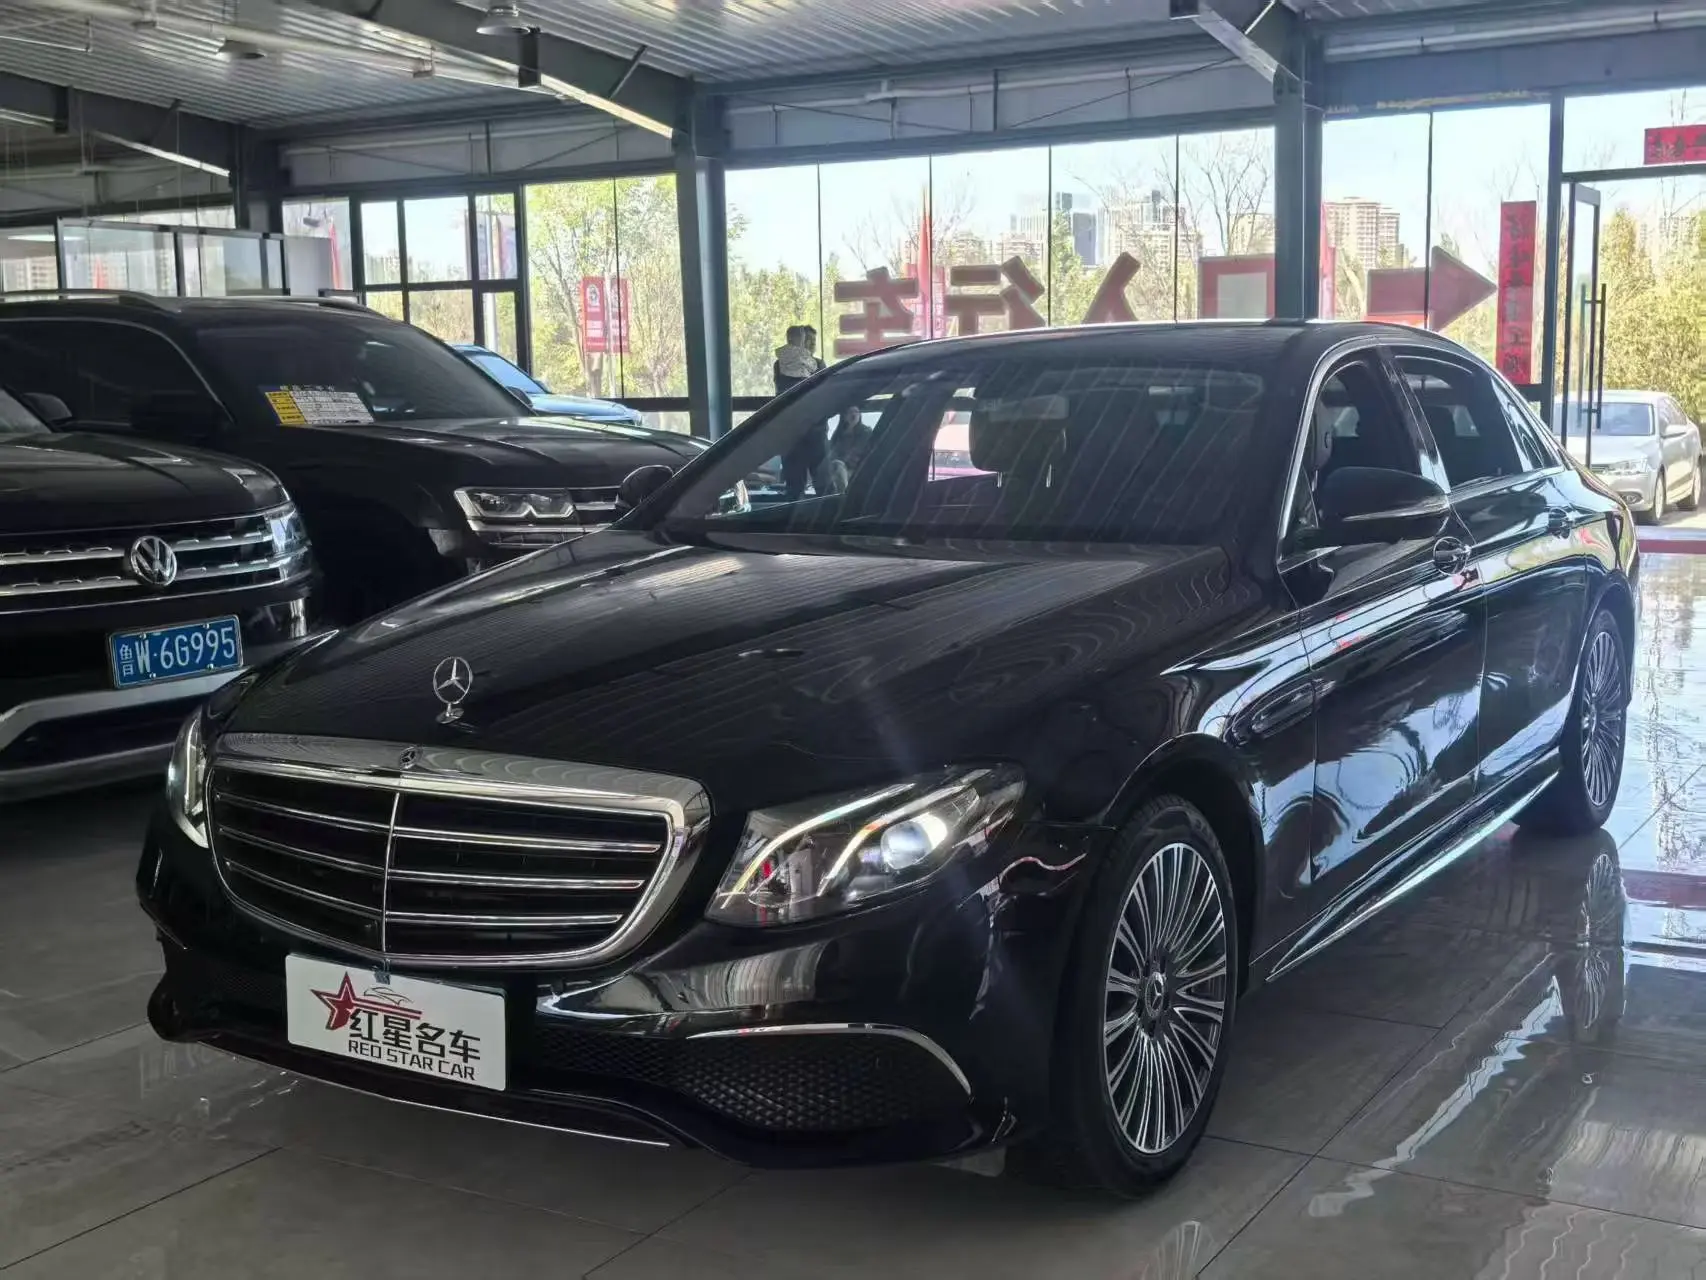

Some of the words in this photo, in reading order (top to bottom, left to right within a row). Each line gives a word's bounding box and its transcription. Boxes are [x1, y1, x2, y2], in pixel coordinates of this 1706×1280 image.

[349, 1008, 481, 1063] 红星名车
[348, 1039, 382, 1059] RED
[386, 1048, 433, 1071] STAR
[438, 1060, 476, 1081] CAR
